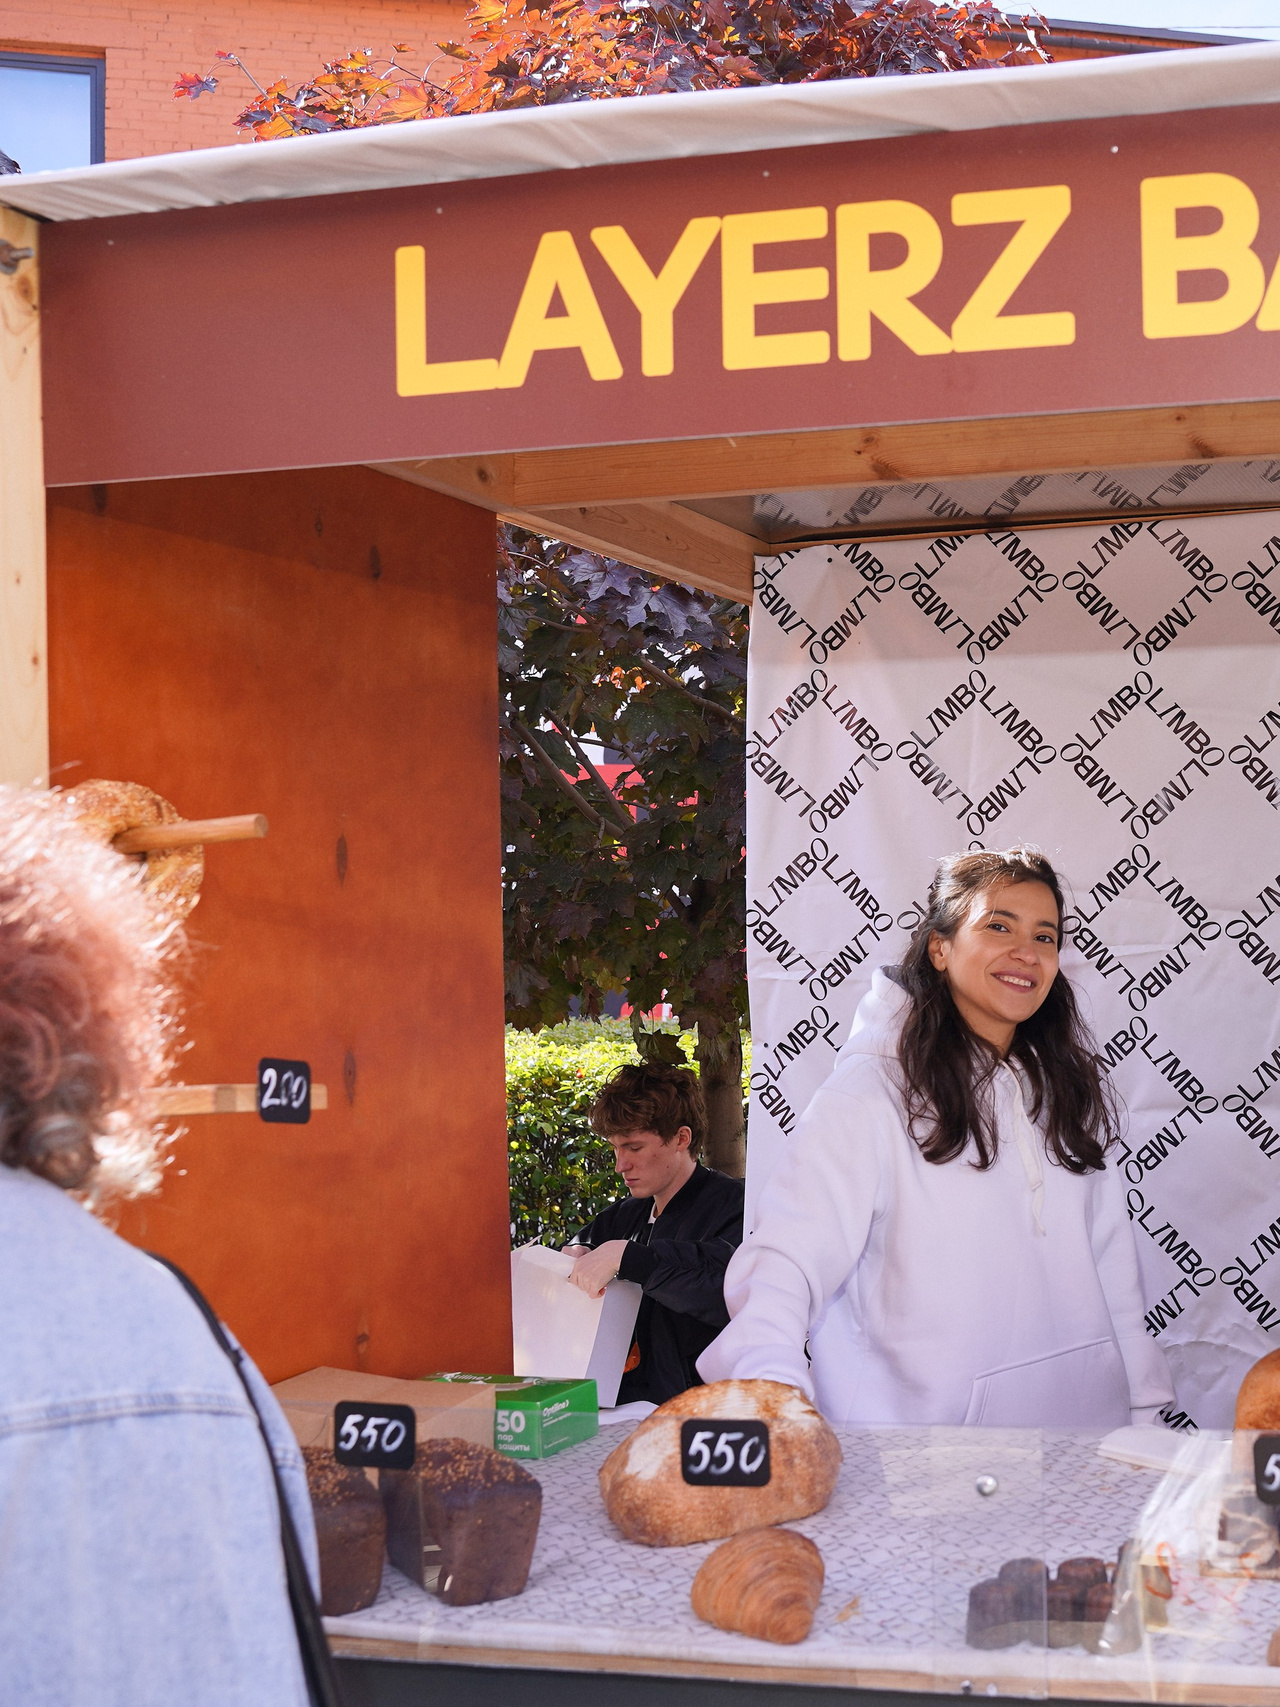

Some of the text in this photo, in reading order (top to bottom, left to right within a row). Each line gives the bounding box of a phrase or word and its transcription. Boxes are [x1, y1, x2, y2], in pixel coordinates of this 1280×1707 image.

[397, 186, 1074, 395] LAYERZ
[914, 535, 972, 580] LIM
[1077, 521, 1144, 579] LIMB
[1146, 520, 1229, 593] LIMBO
[753, 570, 818, 650] LIMBO
[809, 585, 881, 664] LIMBO
[899, 572, 975, 649] LIMBO
[967, 584, 1044, 665] LIMBO
[1062, 571, 1141, 650] LIMBO
[1133, 585, 1212, 666] LIMBO
[753, 669, 828, 748] LIMBO
[822, 684, 893, 761] LIMBO
[910, 670, 986, 749] LIMBO
[979, 685, 1057, 764] LIMBO
[1075, 671, 1153, 751] LIMBO
[1144, 687, 1225, 766] LIMBO
[746, 740, 817, 818] LIMBO
[808, 754, 880, 833] LIMBO
[896, 741, 974, 820] LIMBO
[967, 756, 1041, 836] LIMBO
[1060, 743, 1138, 823] LIMBO
[1130, 758, 1209, 839] LIMBO
[753, 838, 828, 917] LIMBO
[821, 853, 893, 932] LIMBO
[1073, 844, 1150, 924] LIMBO
[1143, 860, 1221, 941] LIMBO
[745, 909, 818, 986] LIMBO
[809, 923, 881, 1001] LIMBO
[1061, 915, 1137, 996] LIMBO
[1128, 932, 1206, 1011] LIMBO
[763, 1006, 829, 1081] LIMBO
[1094, 1016, 1148, 1074] MBO
[1140, 1033, 1219, 1114] LIMBO
[750, 1072, 796, 1137] MBO
[1125, 1105, 1203, 1184] LIMBO
[1137, 1206, 1216, 1287] LIMBO
[338, 1413, 407, 1453] 550
[496, 1410, 526, 1433] 50
[497, 1434, 514, 1442] пар
[498, 1443, 531, 1453] защиты
[687, 1430, 767, 1475] 550
